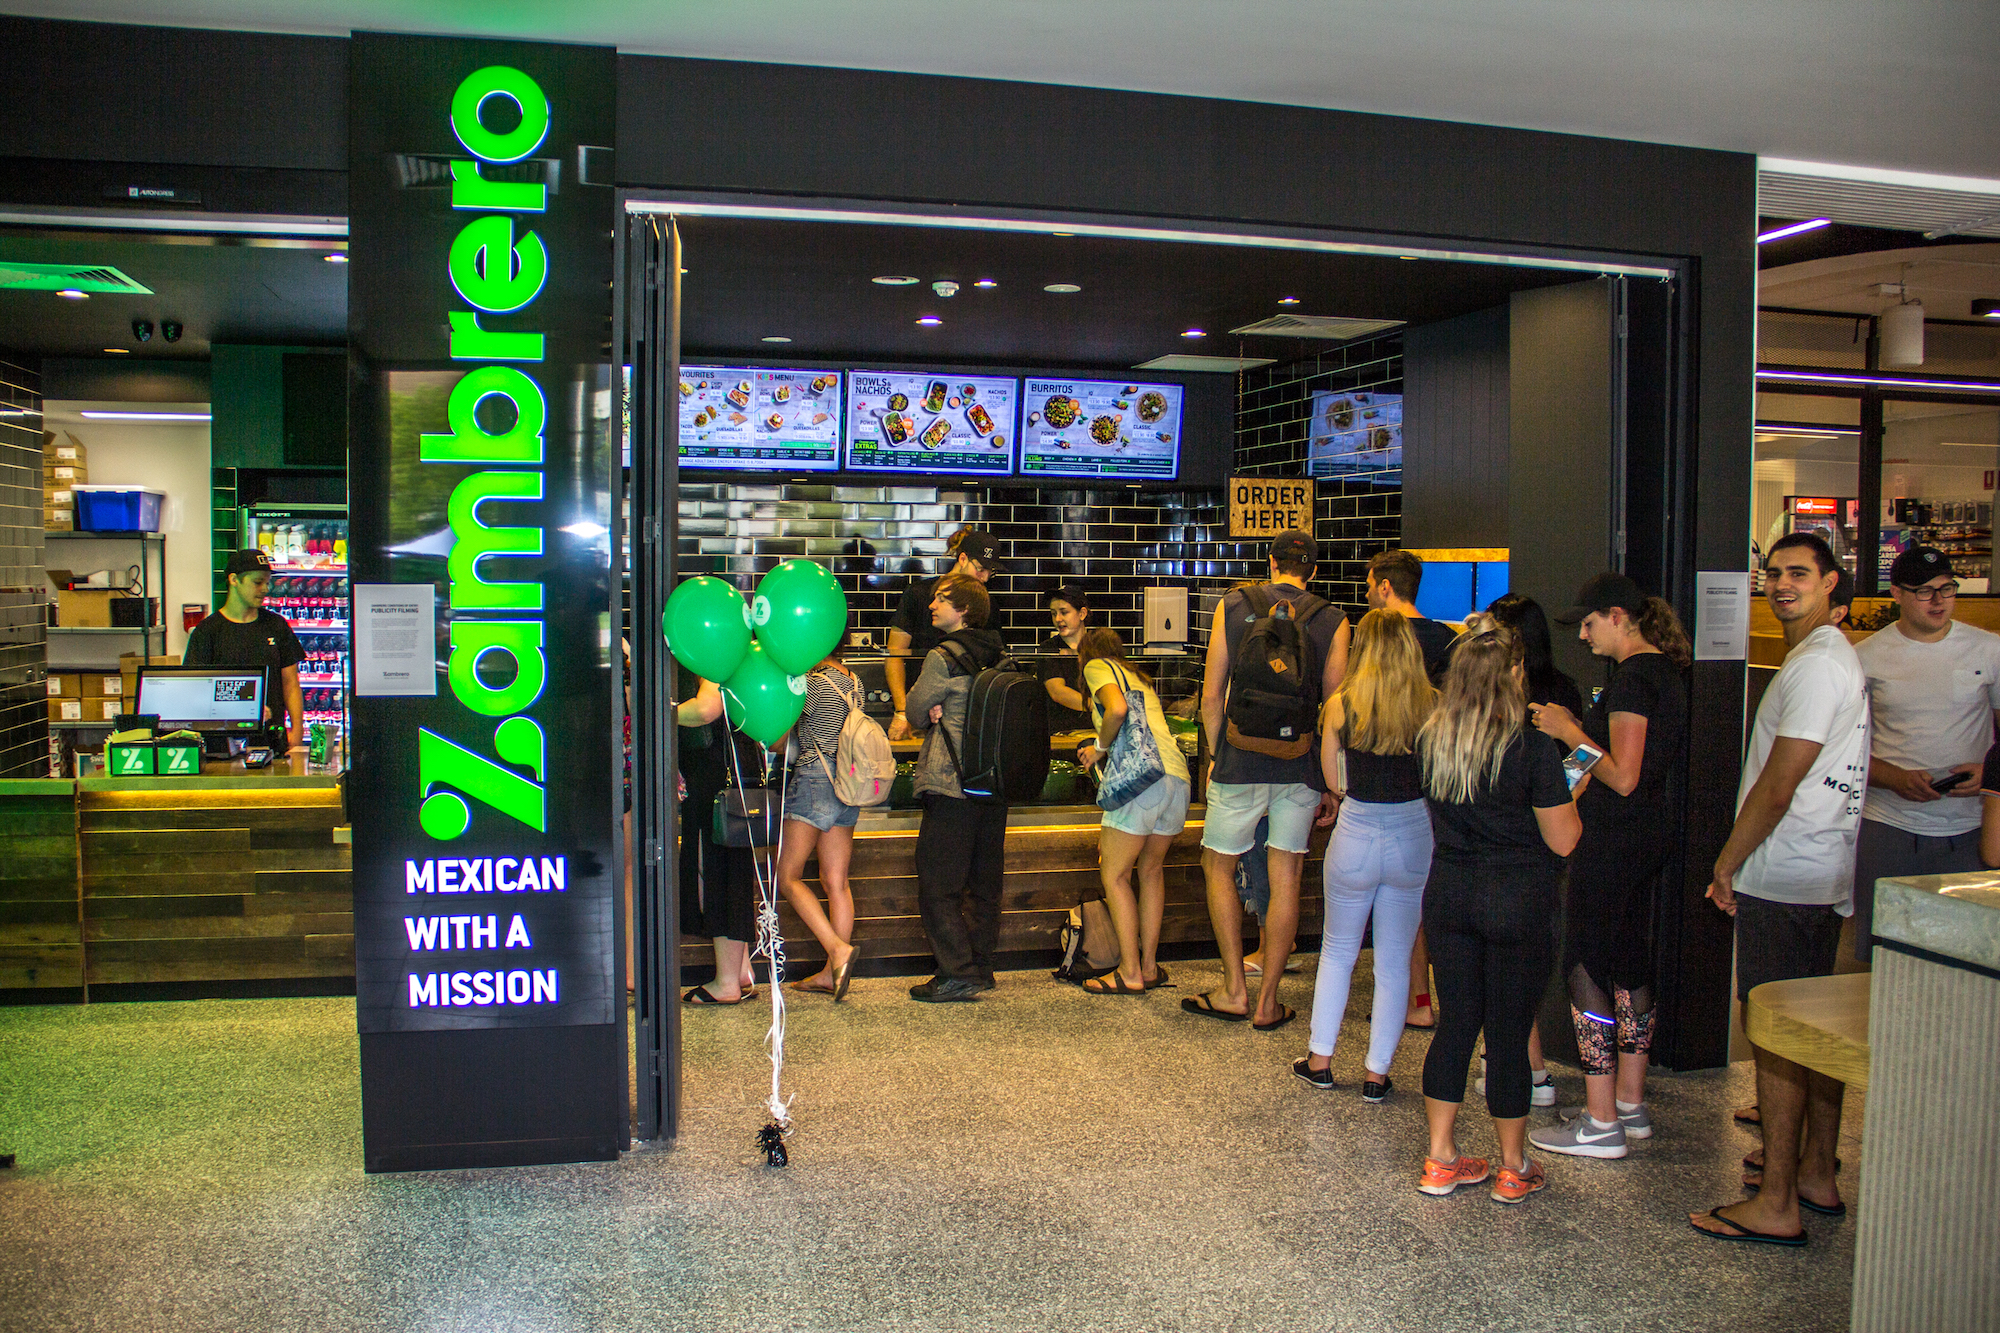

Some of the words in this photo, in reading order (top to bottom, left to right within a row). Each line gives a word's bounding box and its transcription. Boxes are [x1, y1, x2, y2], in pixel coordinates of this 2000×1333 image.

[679, 371, 715, 379] AVOURITES
[757, 373, 774, 381] KIDS
[774, 374, 795, 382] MENU
[855, 376, 887, 387] BOWLS
[855, 385, 892, 395] NACHOS
[1031, 383, 1073, 394] BURRITOS
[854, 442, 878, 450] EXTRAS
[1237, 486, 1305, 505] ORDER
[1244, 510, 1298, 529] HERE
[405, 856, 567, 894] MEXICAN
[404, 914, 499, 950] WITH
[504, 913, 533, 950] A
[408, 969, 560, 1008] MISSION
